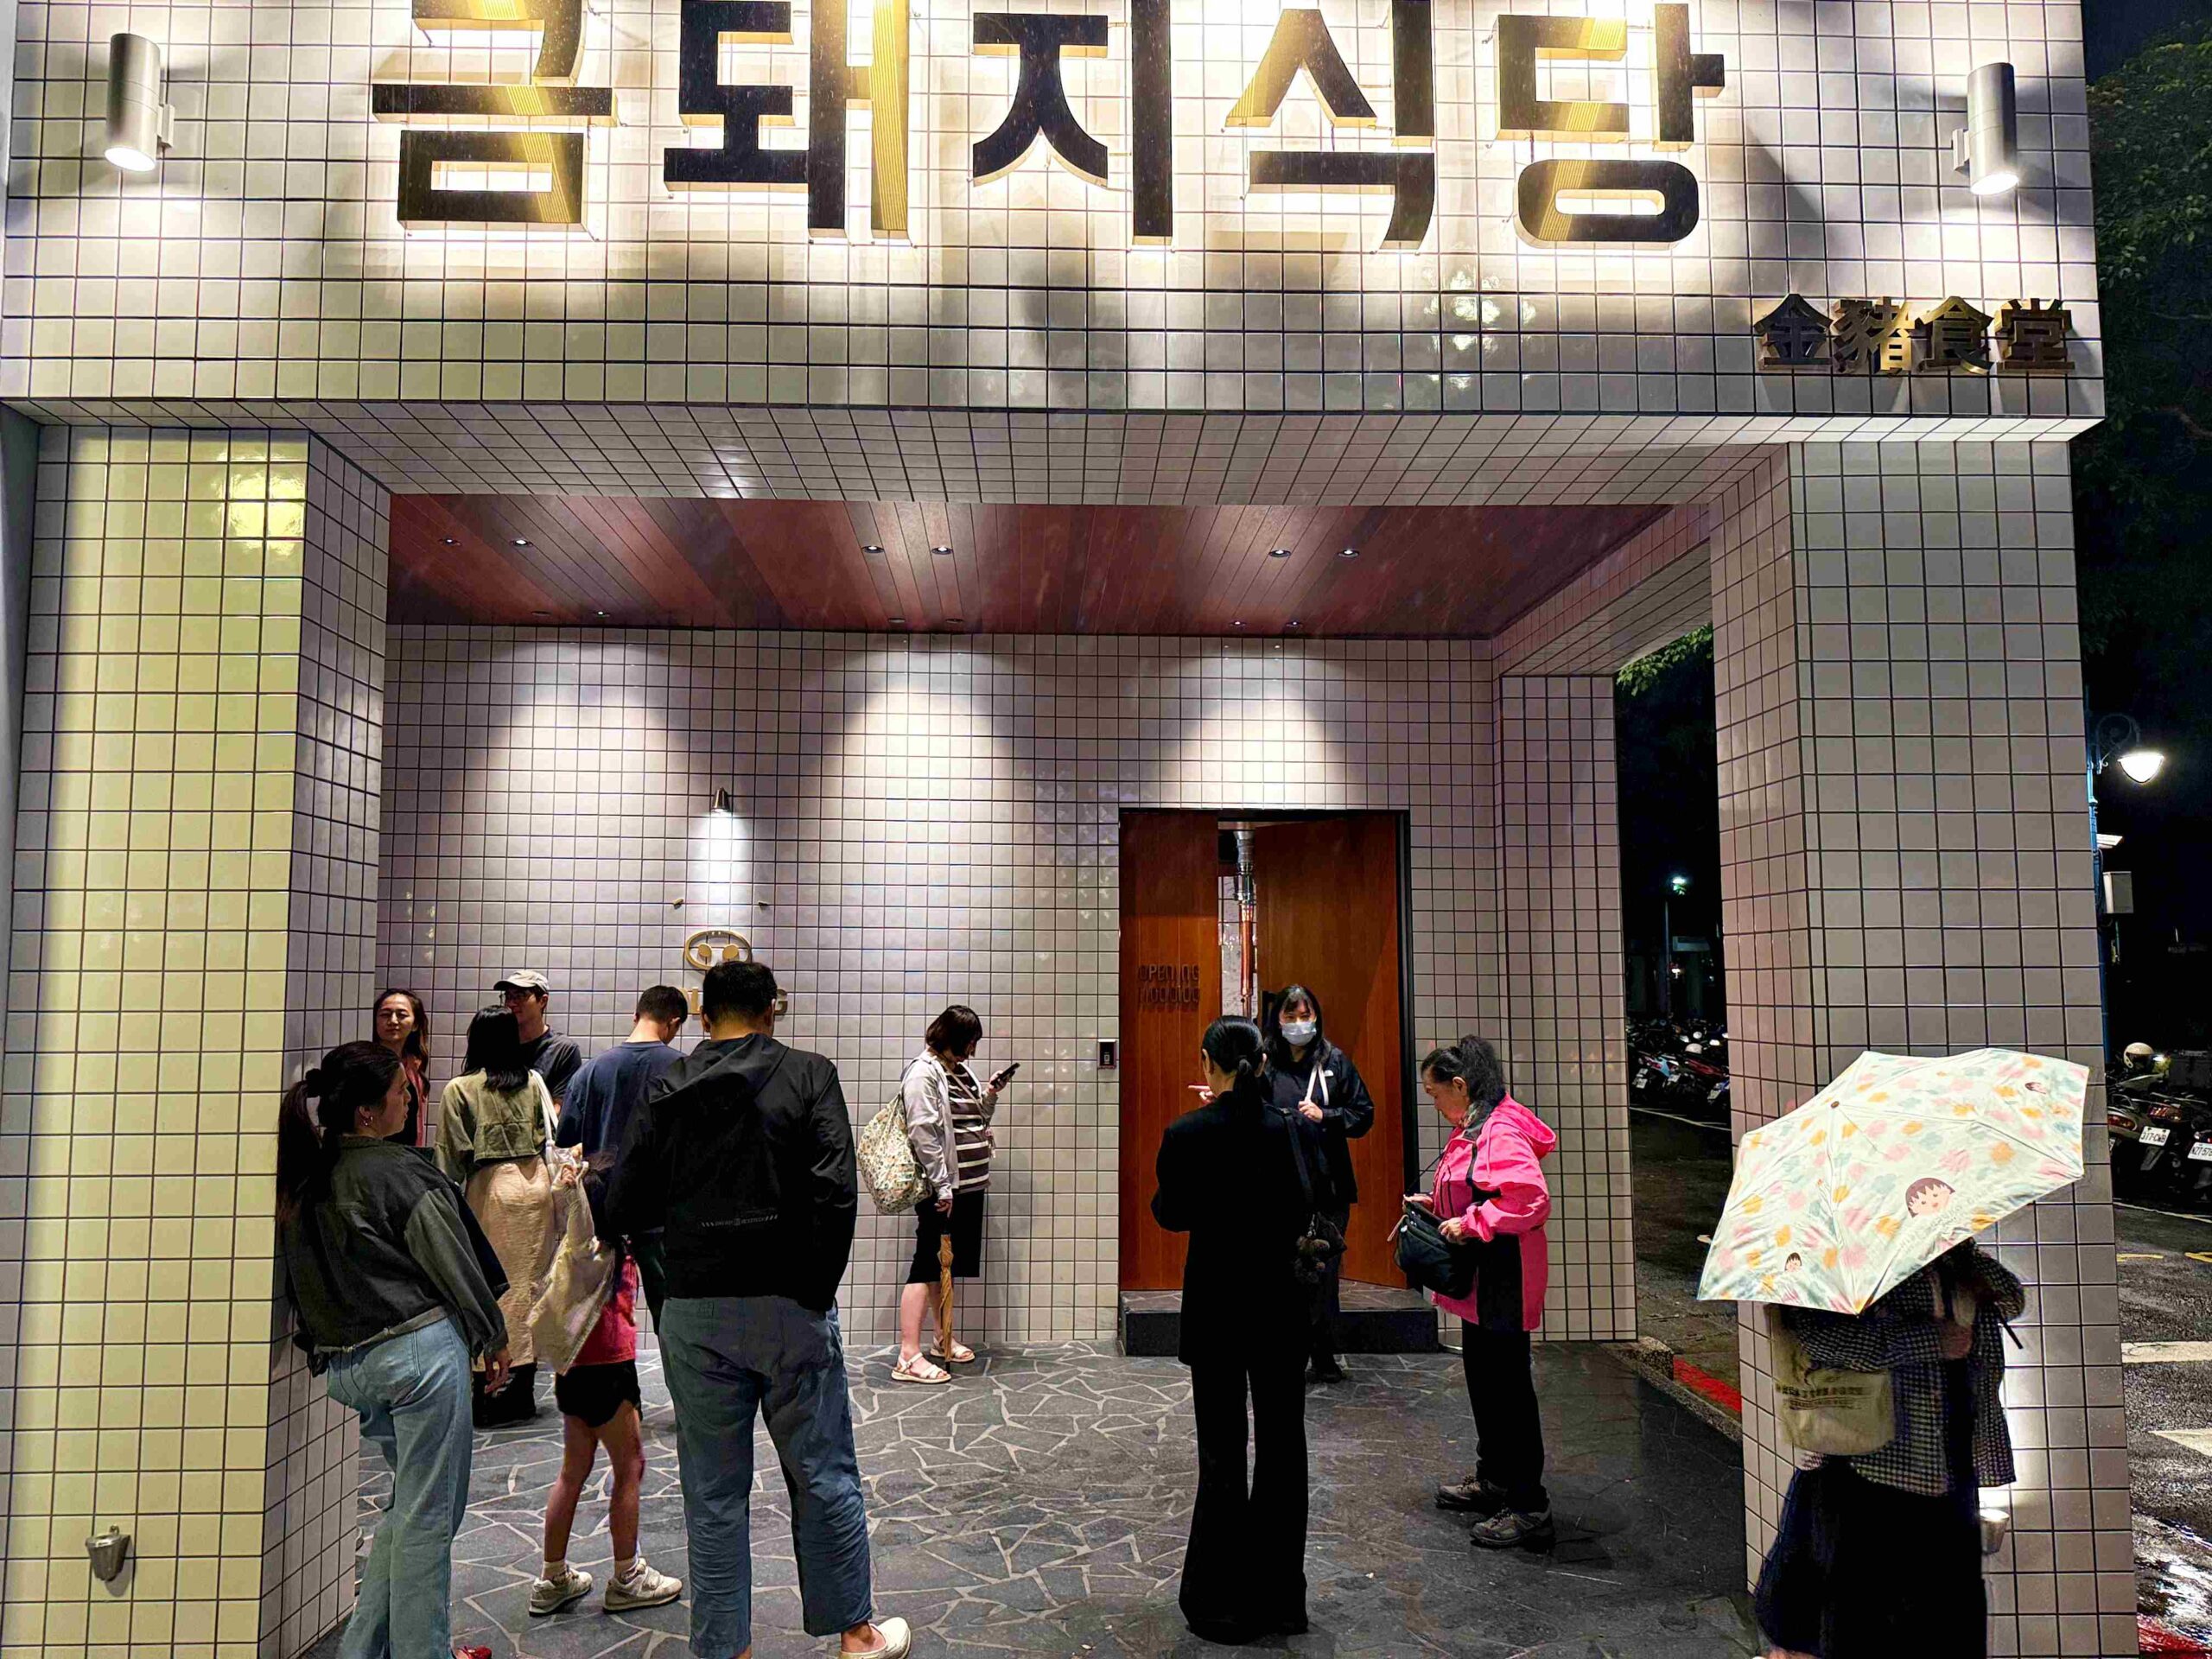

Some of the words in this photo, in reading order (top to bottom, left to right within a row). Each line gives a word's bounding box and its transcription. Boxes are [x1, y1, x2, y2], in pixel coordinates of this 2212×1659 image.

[372, 0, 1726, 249] 금돼지식당
[1754, 292, 2075, 375] 金豬食堂
